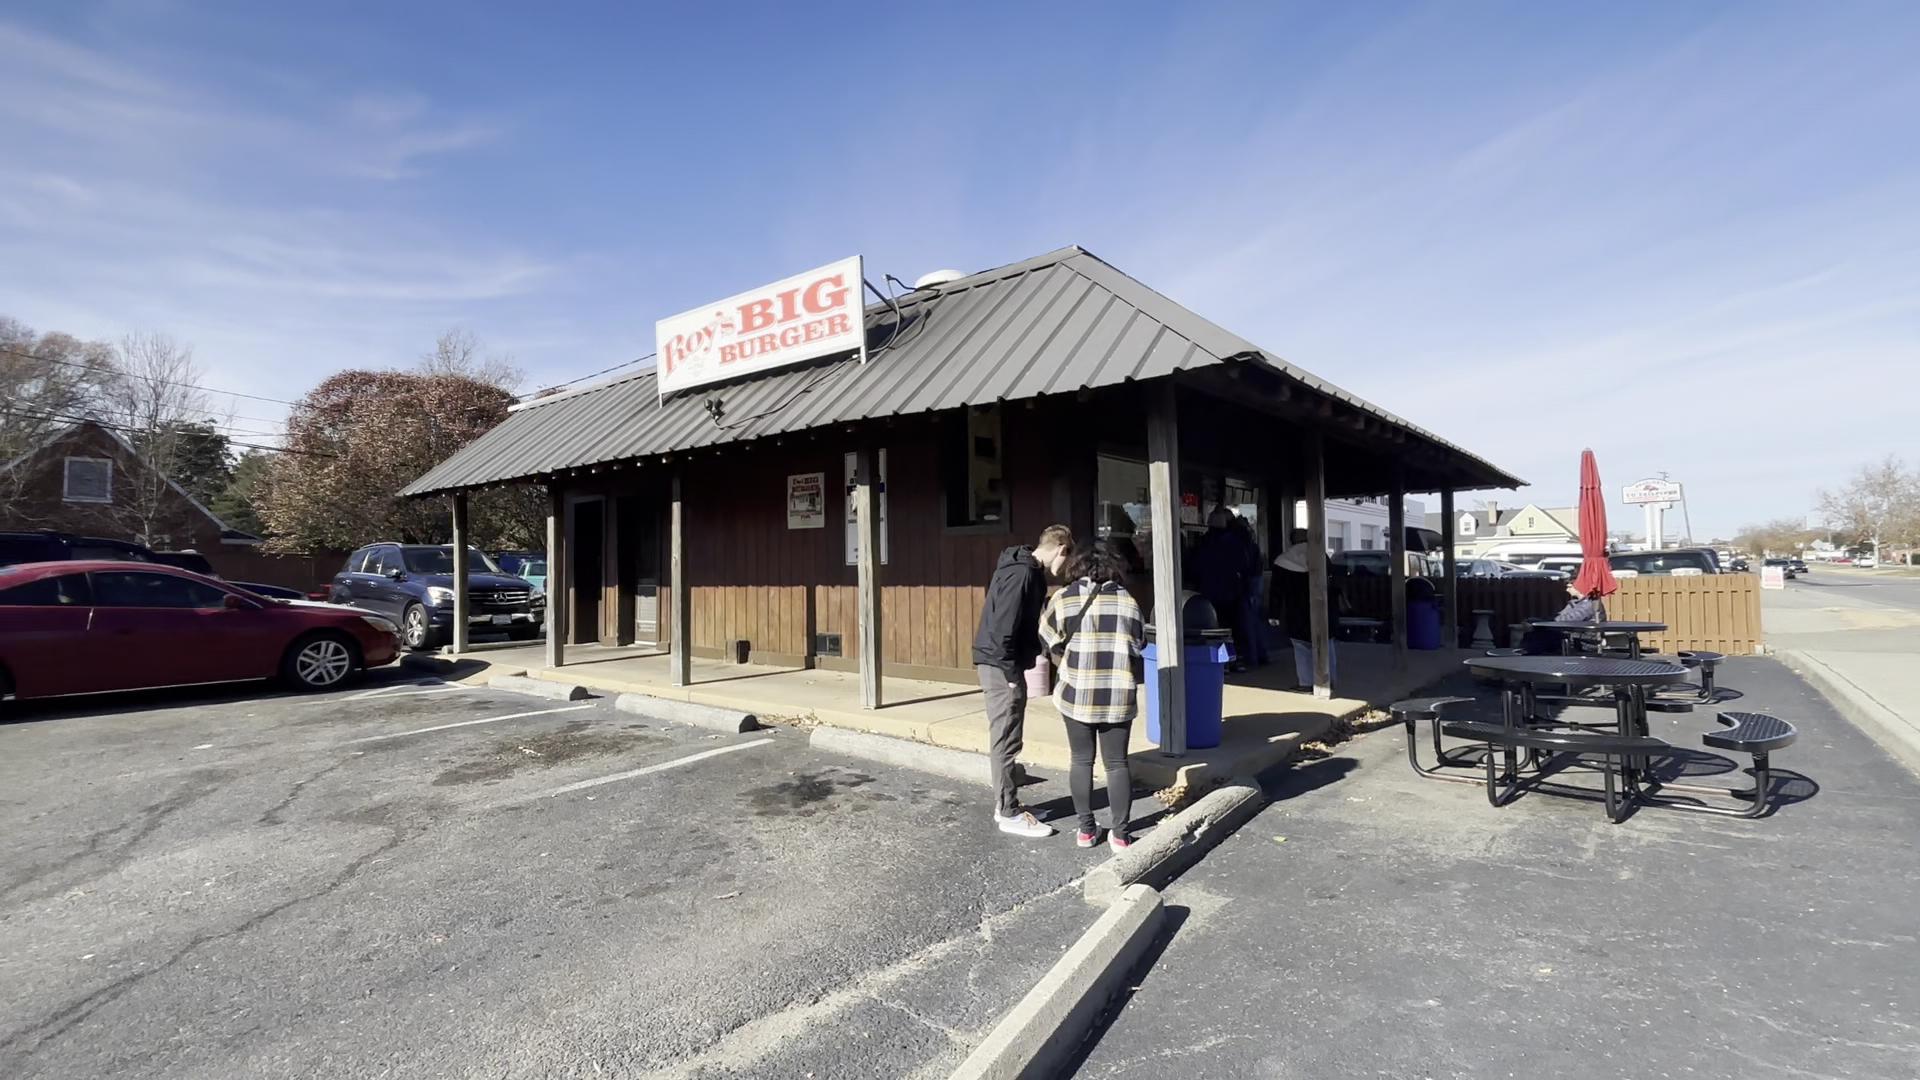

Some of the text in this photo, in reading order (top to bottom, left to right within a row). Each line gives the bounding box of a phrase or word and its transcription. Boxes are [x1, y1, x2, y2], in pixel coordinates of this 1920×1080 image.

[663, 273, 850, 376] Roy's BIG
[719, 313, 851, 365] BURGER
